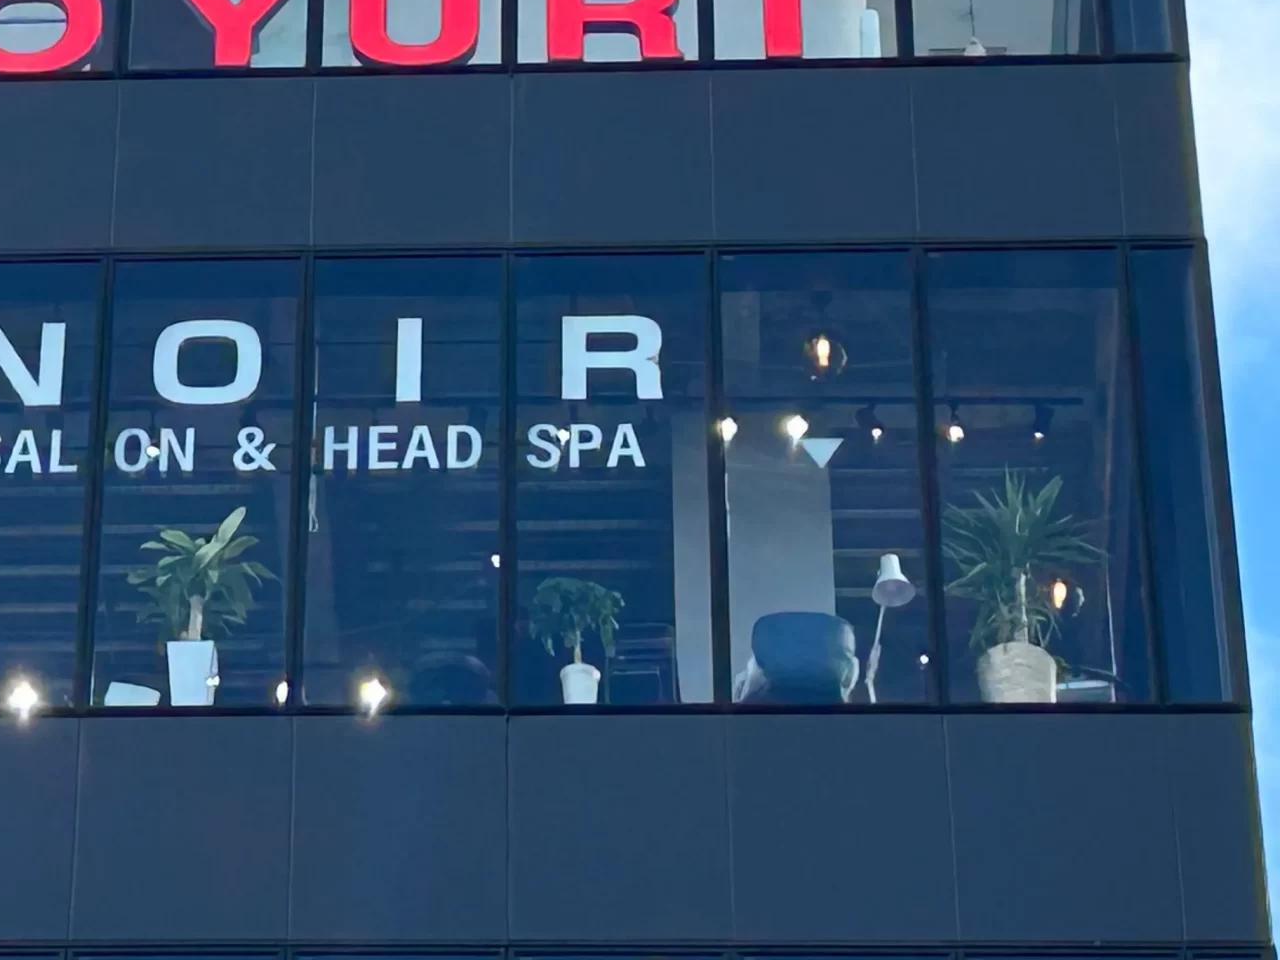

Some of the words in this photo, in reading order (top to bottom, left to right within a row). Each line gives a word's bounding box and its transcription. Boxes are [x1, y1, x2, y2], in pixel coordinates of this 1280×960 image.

[235, 425, 278, 474] &
[323, 424, 483, 472] HEAD
[525, 422, 647, 470] SPA
